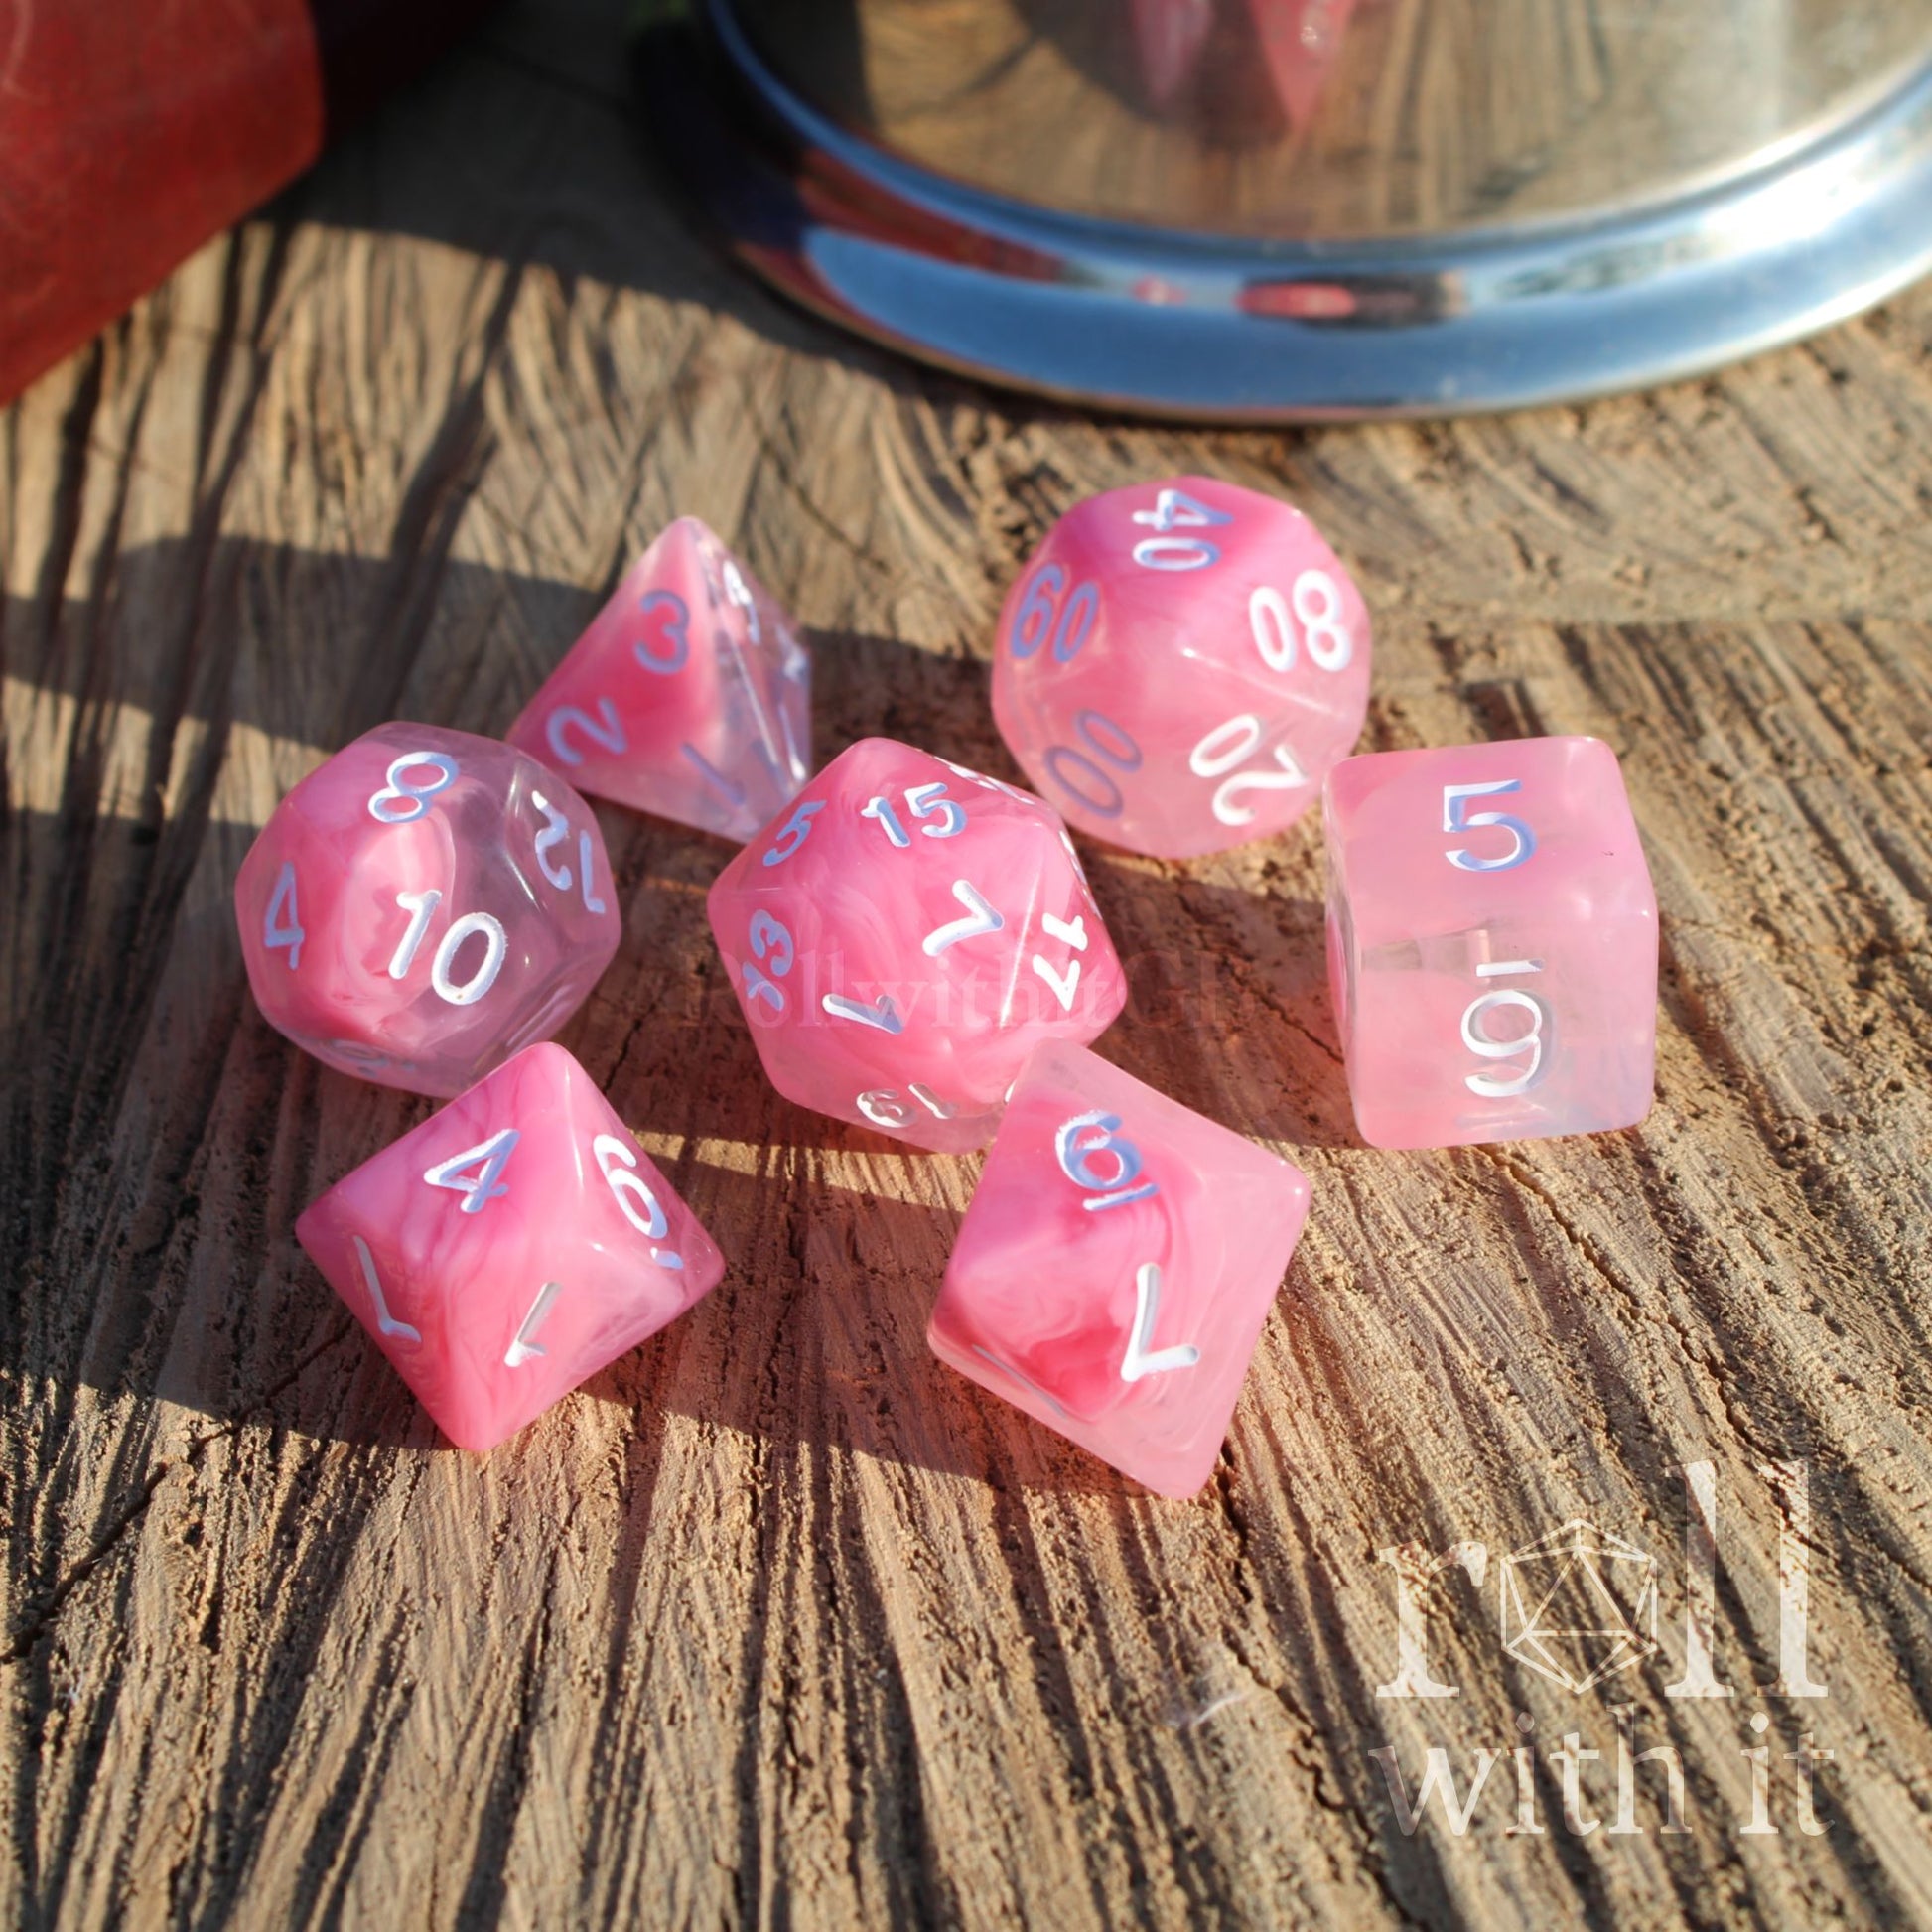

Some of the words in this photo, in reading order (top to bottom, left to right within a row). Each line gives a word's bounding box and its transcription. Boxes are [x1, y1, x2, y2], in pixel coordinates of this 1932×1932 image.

[1132, 488, 1234, 572] 40
[632, 588, 690, 676] 3
[547, 697, 628, 767] 2
[1042, 708, 1144, 820] 00
[1189, 713, 1309, 827] 20
[368, 751, 460, 823] 8
[860, 781, 968, 848] 15
[1443, 779, 1538, 873] 5
[762, 799, 827, 867] 5
[263, 860, 305, 971] 4
[388, 889, 509, 1006] 10
[423, 1128, 520, 1213] 4
